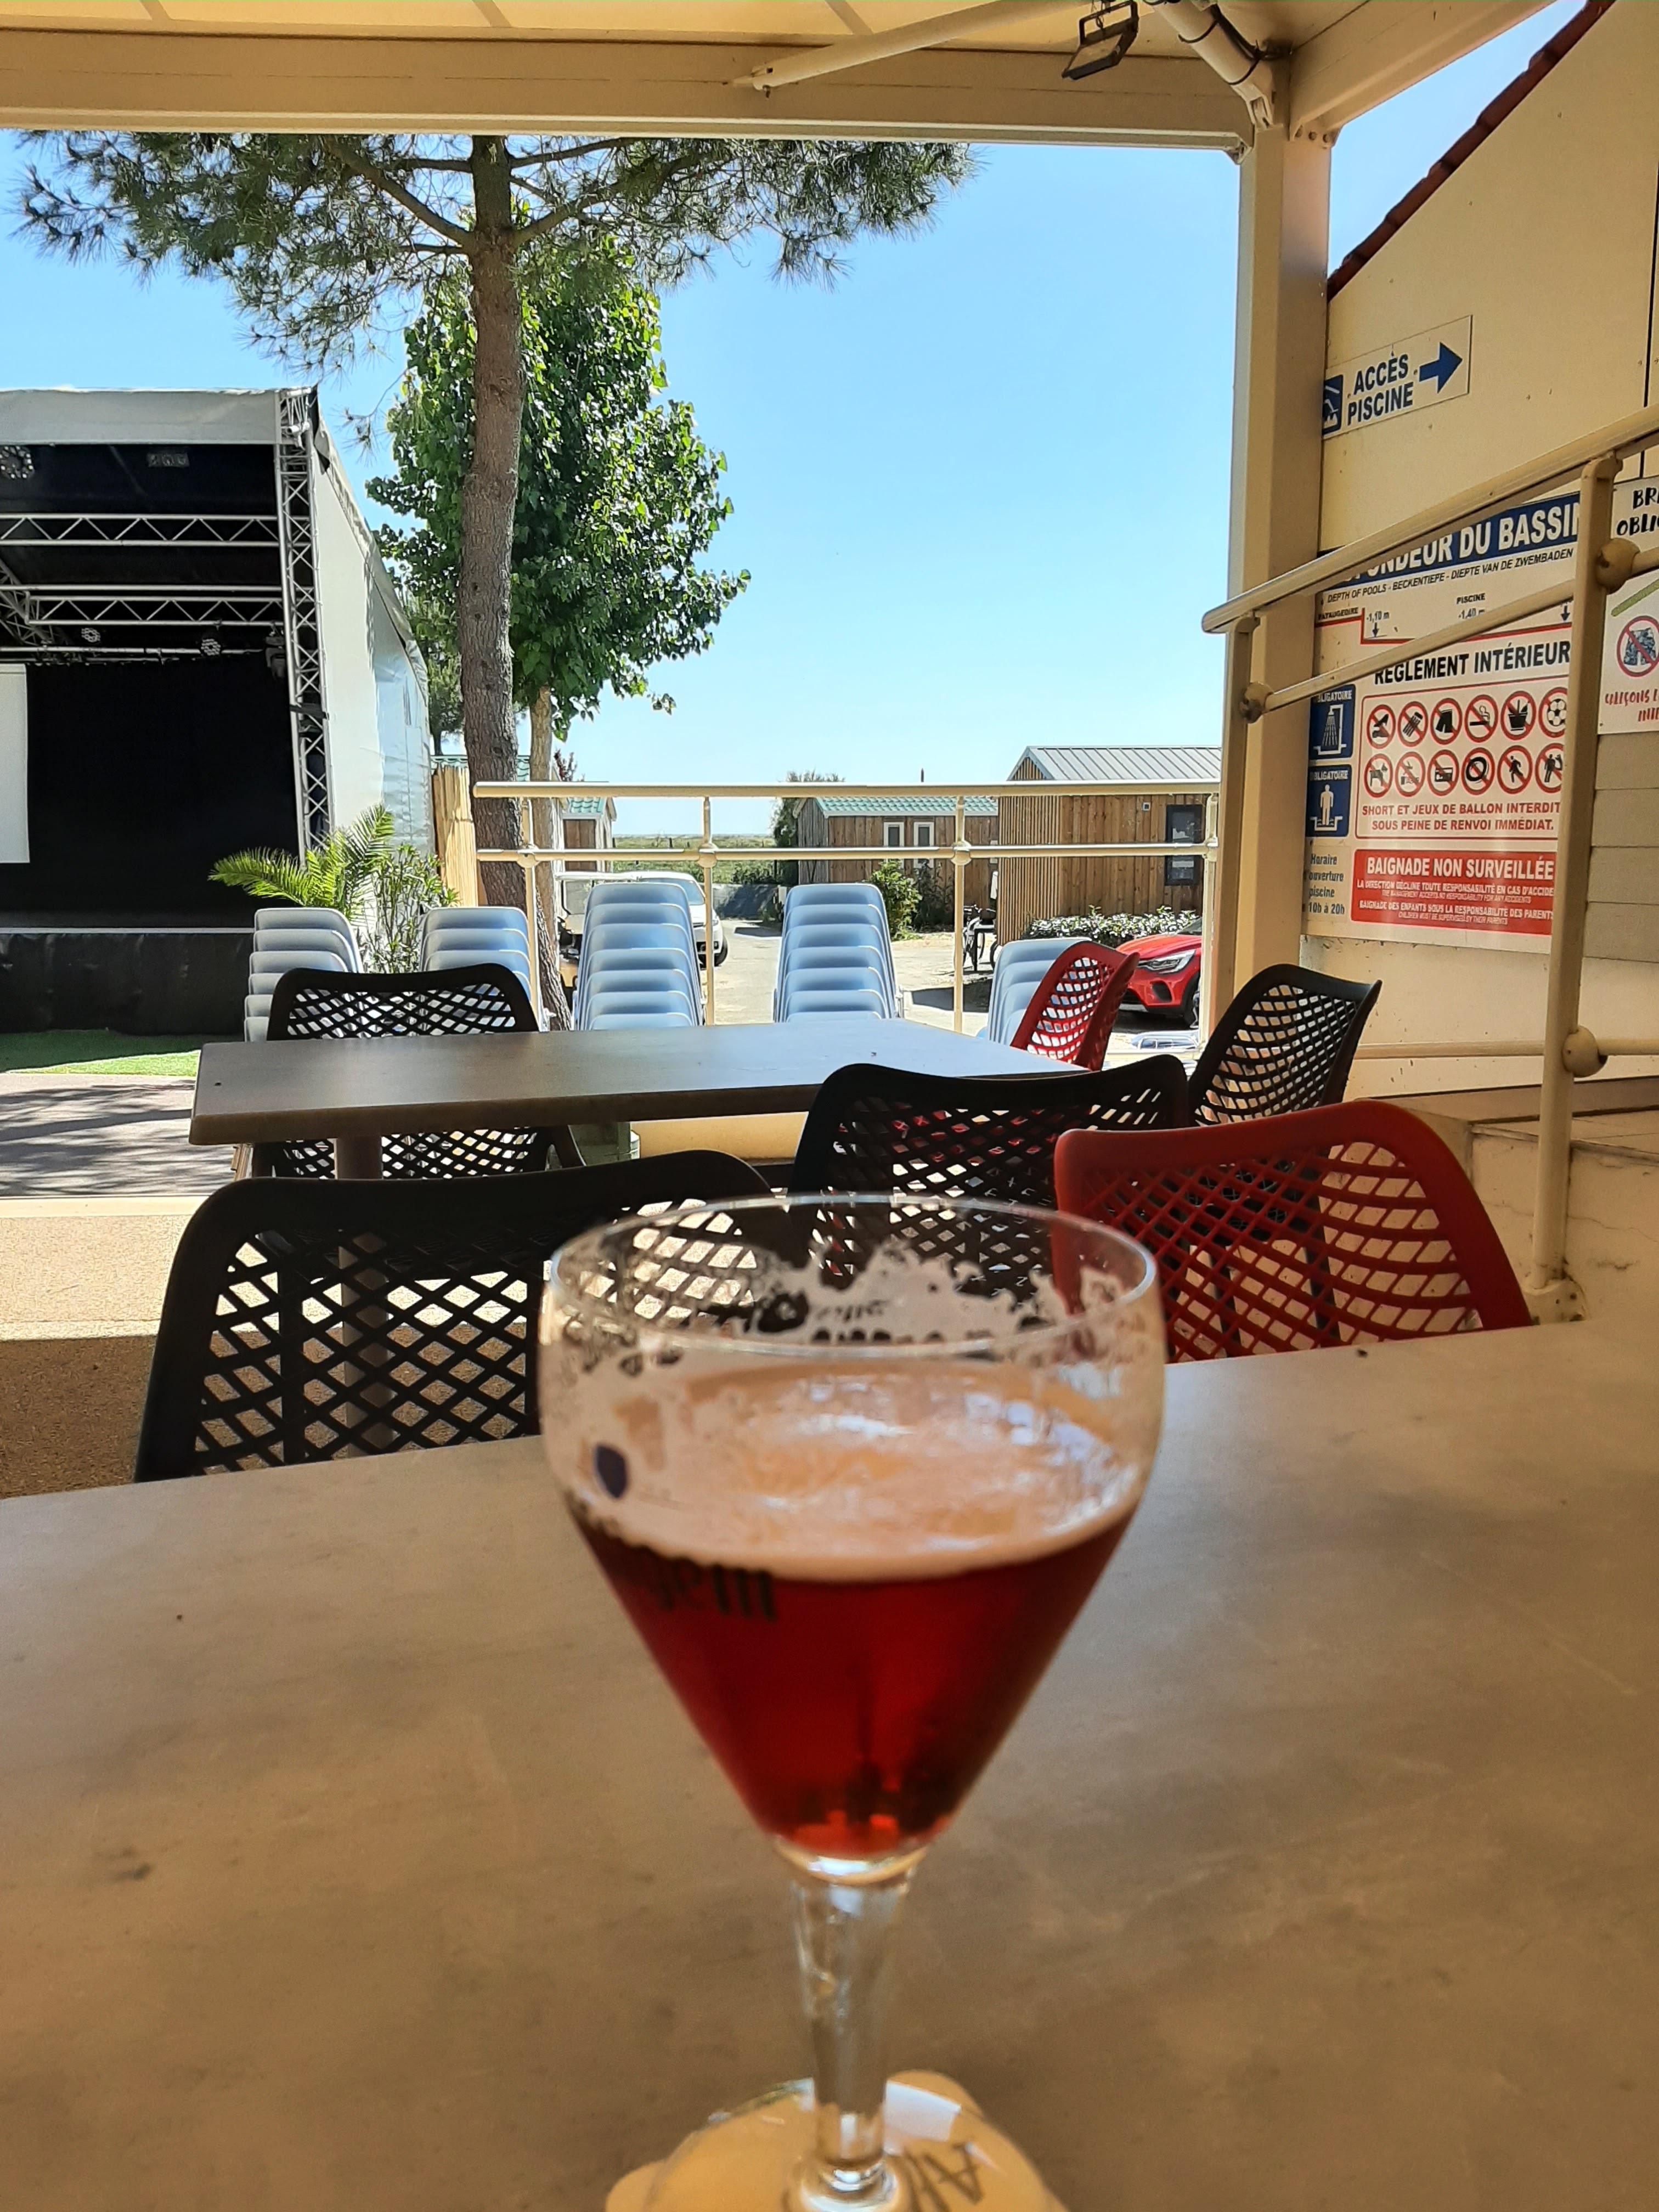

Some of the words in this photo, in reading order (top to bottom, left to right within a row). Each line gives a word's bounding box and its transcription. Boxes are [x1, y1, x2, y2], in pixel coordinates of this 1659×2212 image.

[1347, 381, 1414, 426] PISCINE
[1633, 487, 1659, 510] BR
[1616, 514, 1659, 536] OBLI
[1459, 521, 1491, 558] DU
[1327, 590, 1350, 603] DEPTH
[1351, 589, 1361, 598] OF
[1362, 583, 1386, 596] POOLS
[1451, 566, 1481, 579] DIEPTE
[1482, 561, 1499, 573] VAN
[1500, 559, 1513, 571] DE
[1457, 592, 1485, 605] PISCINE
[1474, 641, 1571, 673] INTÉRIEUR
[1362, 805, 1394, 816] SHORT
[1397, 805, 1409, 815] ET
[1412, 804, 1439, 815] JEUX
[1442, 804, 1456, 814] DE
[1459, 803, 1503, 814] BALLON
[1372, 820, 1398, 830] SOUS
[1401, 820, 1431, 830] PEINE
[1434, 820, 1447, 830] DE
[1451, 820, 1491, 830] RENVOI
[1495, 816, 1554, 830] IMMÉDIAT.
[1310, 854, 1337, 865] Horaire
[1367, 857, 1430, 876] BAIGNADE
[1433, 858, 1463, 877] NON
[1465, 855, 1555, 880] SURVEILLÉE
[1308, 871, 1344, 882] ouverture
[1357, 878, 1364, 889] LA
[1365, 880, 1395, 889] DIRECTION
[1421, 882, 1442, 891] TOUTE
[1497, 885, 1506, 894] EN
[1507, 885, 1521, 895] CAS
[1522, 886, 1554, 896] D'ACCIDE
[1331, 904, 1345, 915] 20h
[1388, 901, 1400, 910] DES
[1401, 902, 1426, 912] ENFANTS
[1427, 904, 1444, 913] SOUS
[1445, 904, 1453, 913] LA
[1454, 905, 1508, 917] RESPONSABILITÉ
[1510, 909, 1523, 918] DES
